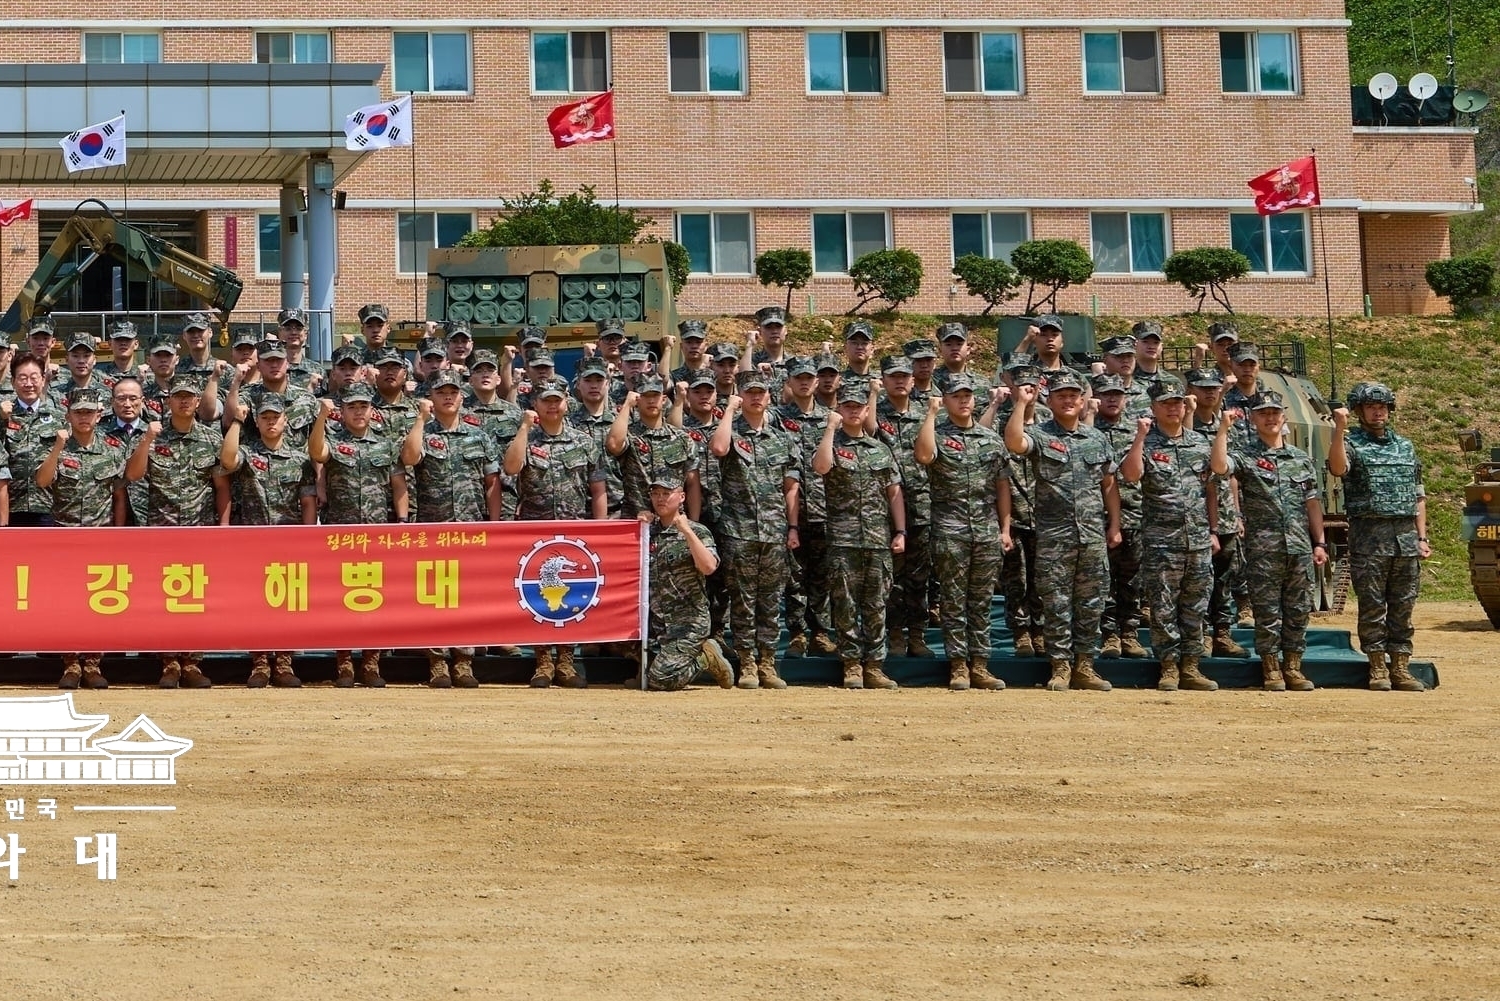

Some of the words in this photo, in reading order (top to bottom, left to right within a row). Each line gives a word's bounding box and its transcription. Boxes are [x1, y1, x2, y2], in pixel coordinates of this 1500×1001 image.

[326, 532, 372, 554] 정의와
[377, 531, 429, 549] 자유를
[435, 531, 489, 548] 위하여
[1476, 525, 1500, 540] 해
[87, 564, 208, 614] 강한
[265, 559, 459, 611] 해병대
